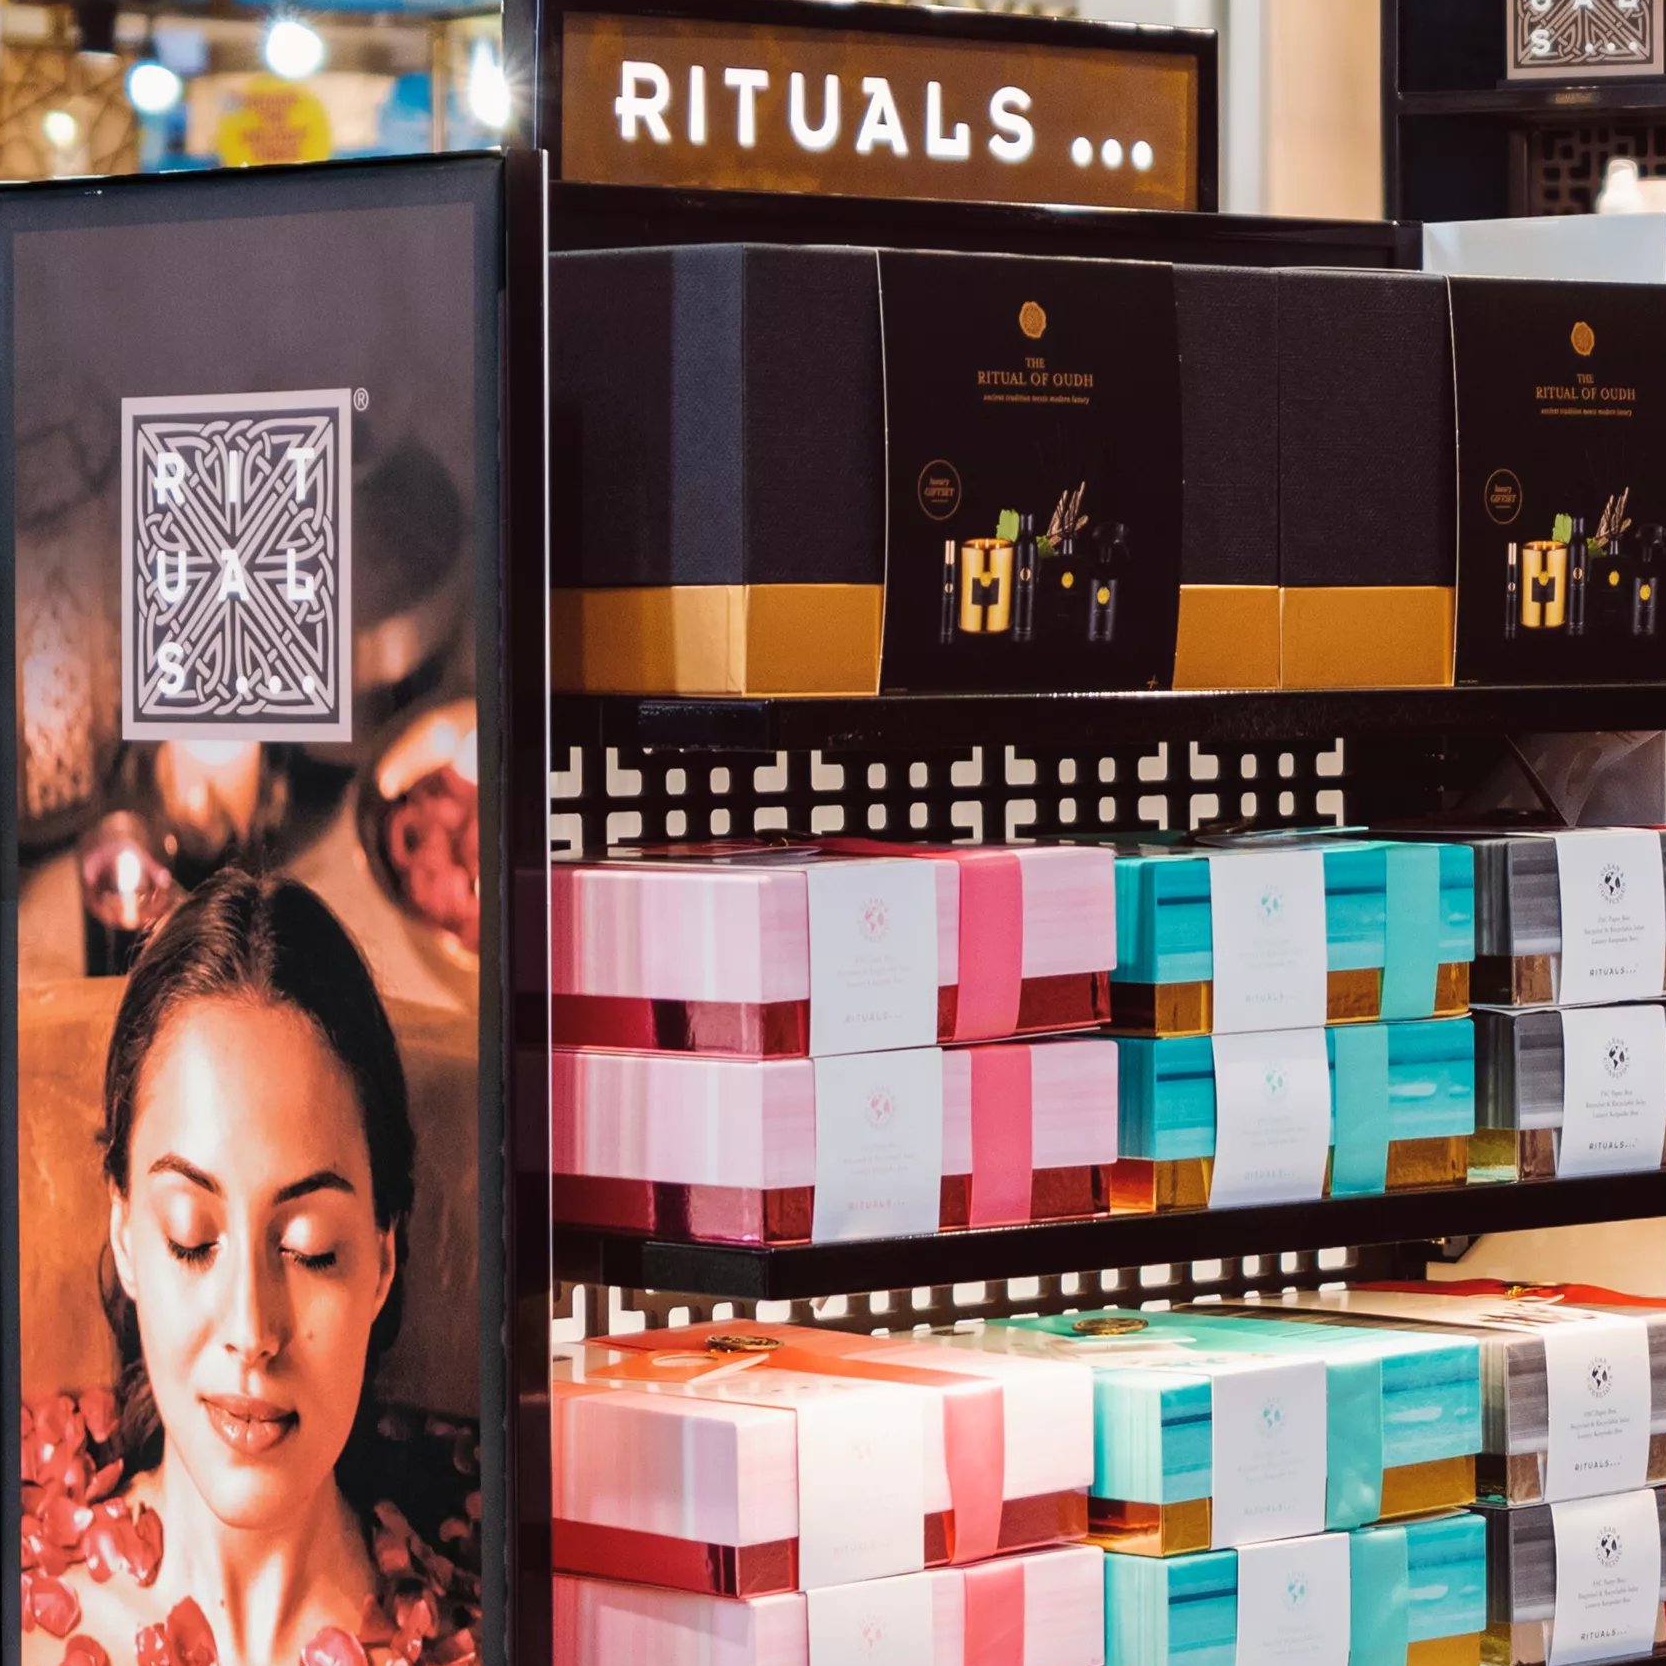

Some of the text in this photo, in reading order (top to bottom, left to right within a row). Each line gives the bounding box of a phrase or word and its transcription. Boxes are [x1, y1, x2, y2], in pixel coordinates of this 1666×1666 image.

[1025, 357, 1045, 369] THE
[977, 371, 1093, 388] RITUAL OF OUDH
[1576, 373, 1594, 384] THE
[1536, 386, 1636, 401] RITUAL OF OUDH
